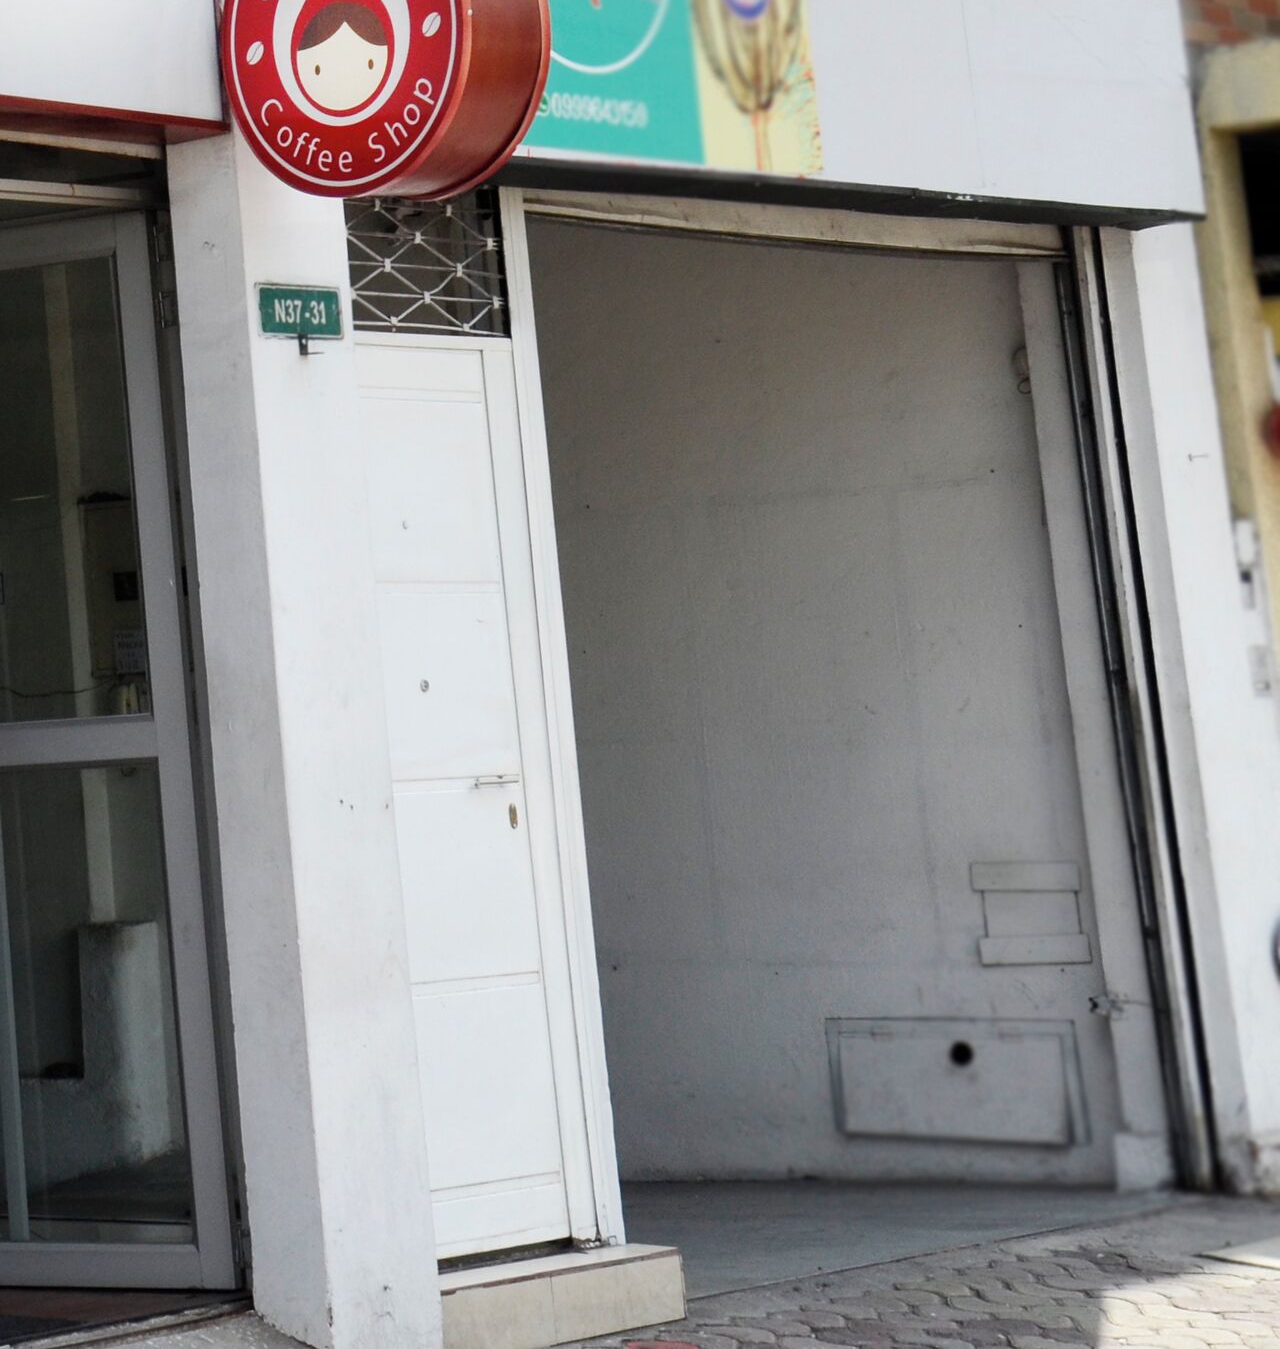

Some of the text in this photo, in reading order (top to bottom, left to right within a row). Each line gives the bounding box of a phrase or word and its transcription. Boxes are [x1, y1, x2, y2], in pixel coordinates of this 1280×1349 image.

[260, 76, 438, 173] Coffee Shop
[273, 298, 327, 326] N37-31
